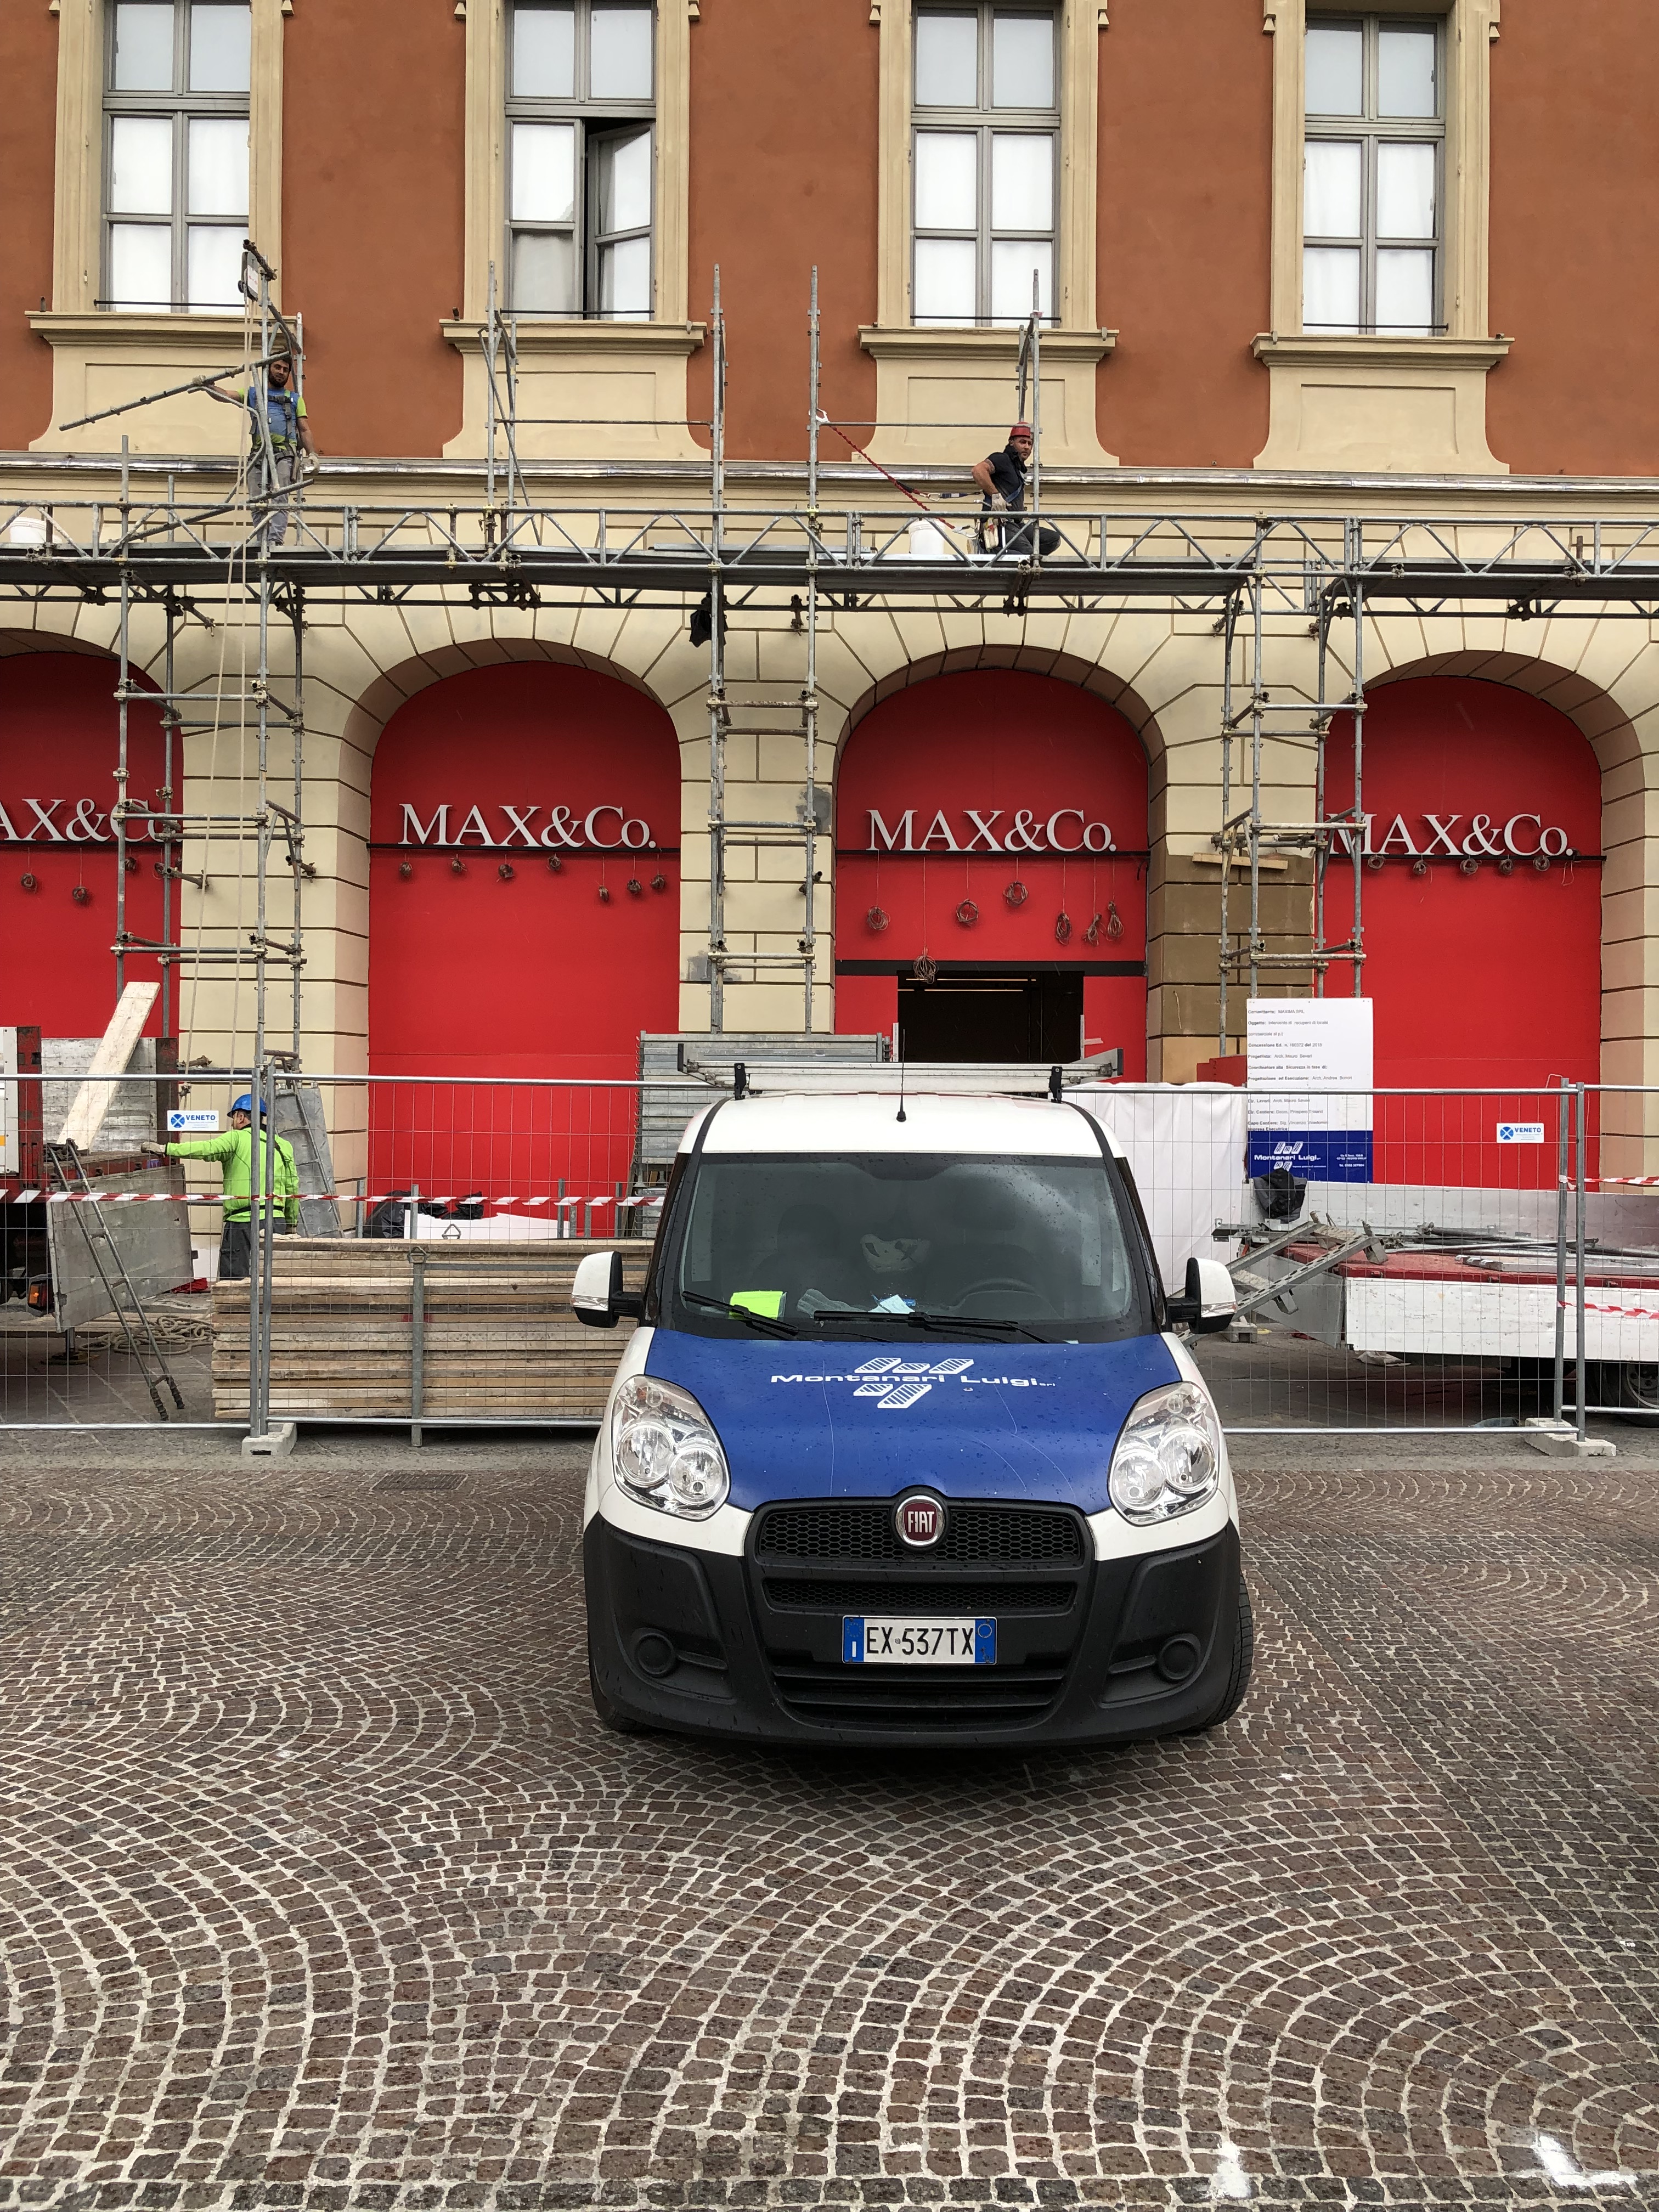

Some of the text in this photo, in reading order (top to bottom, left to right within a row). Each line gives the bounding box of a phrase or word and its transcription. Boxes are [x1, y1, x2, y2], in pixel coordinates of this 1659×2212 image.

[398, 803, 657, 849] MAX&Co.
[865, 809, 1117, 853] MAX&Co.
[960, 1376, 1039, 1387] Luigi
[907, 1511, 935, 1533] FIAT
